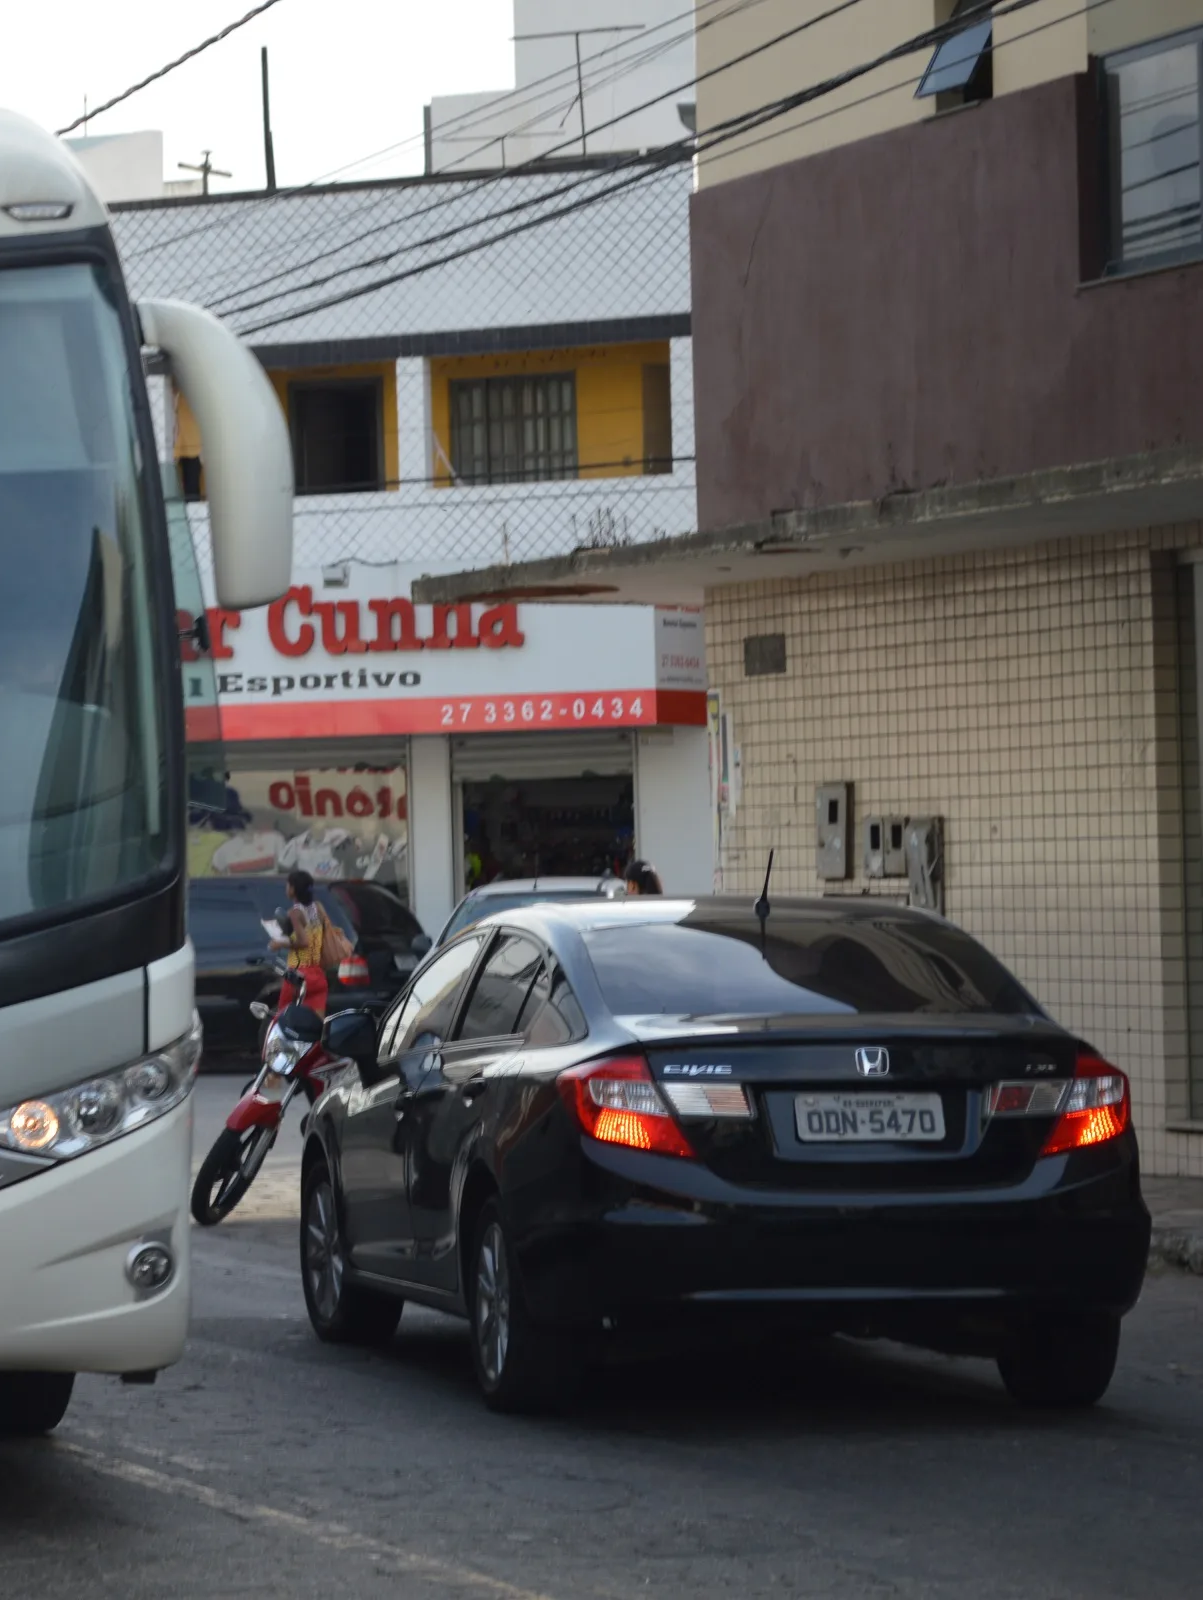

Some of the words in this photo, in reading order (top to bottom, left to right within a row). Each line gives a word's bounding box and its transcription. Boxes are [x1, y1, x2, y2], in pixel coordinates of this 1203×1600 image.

[217, 667, 422, 697] Esportivo
[441, 702, 472, 726] 27
[484, 696, 644, 723] 3362-0434
